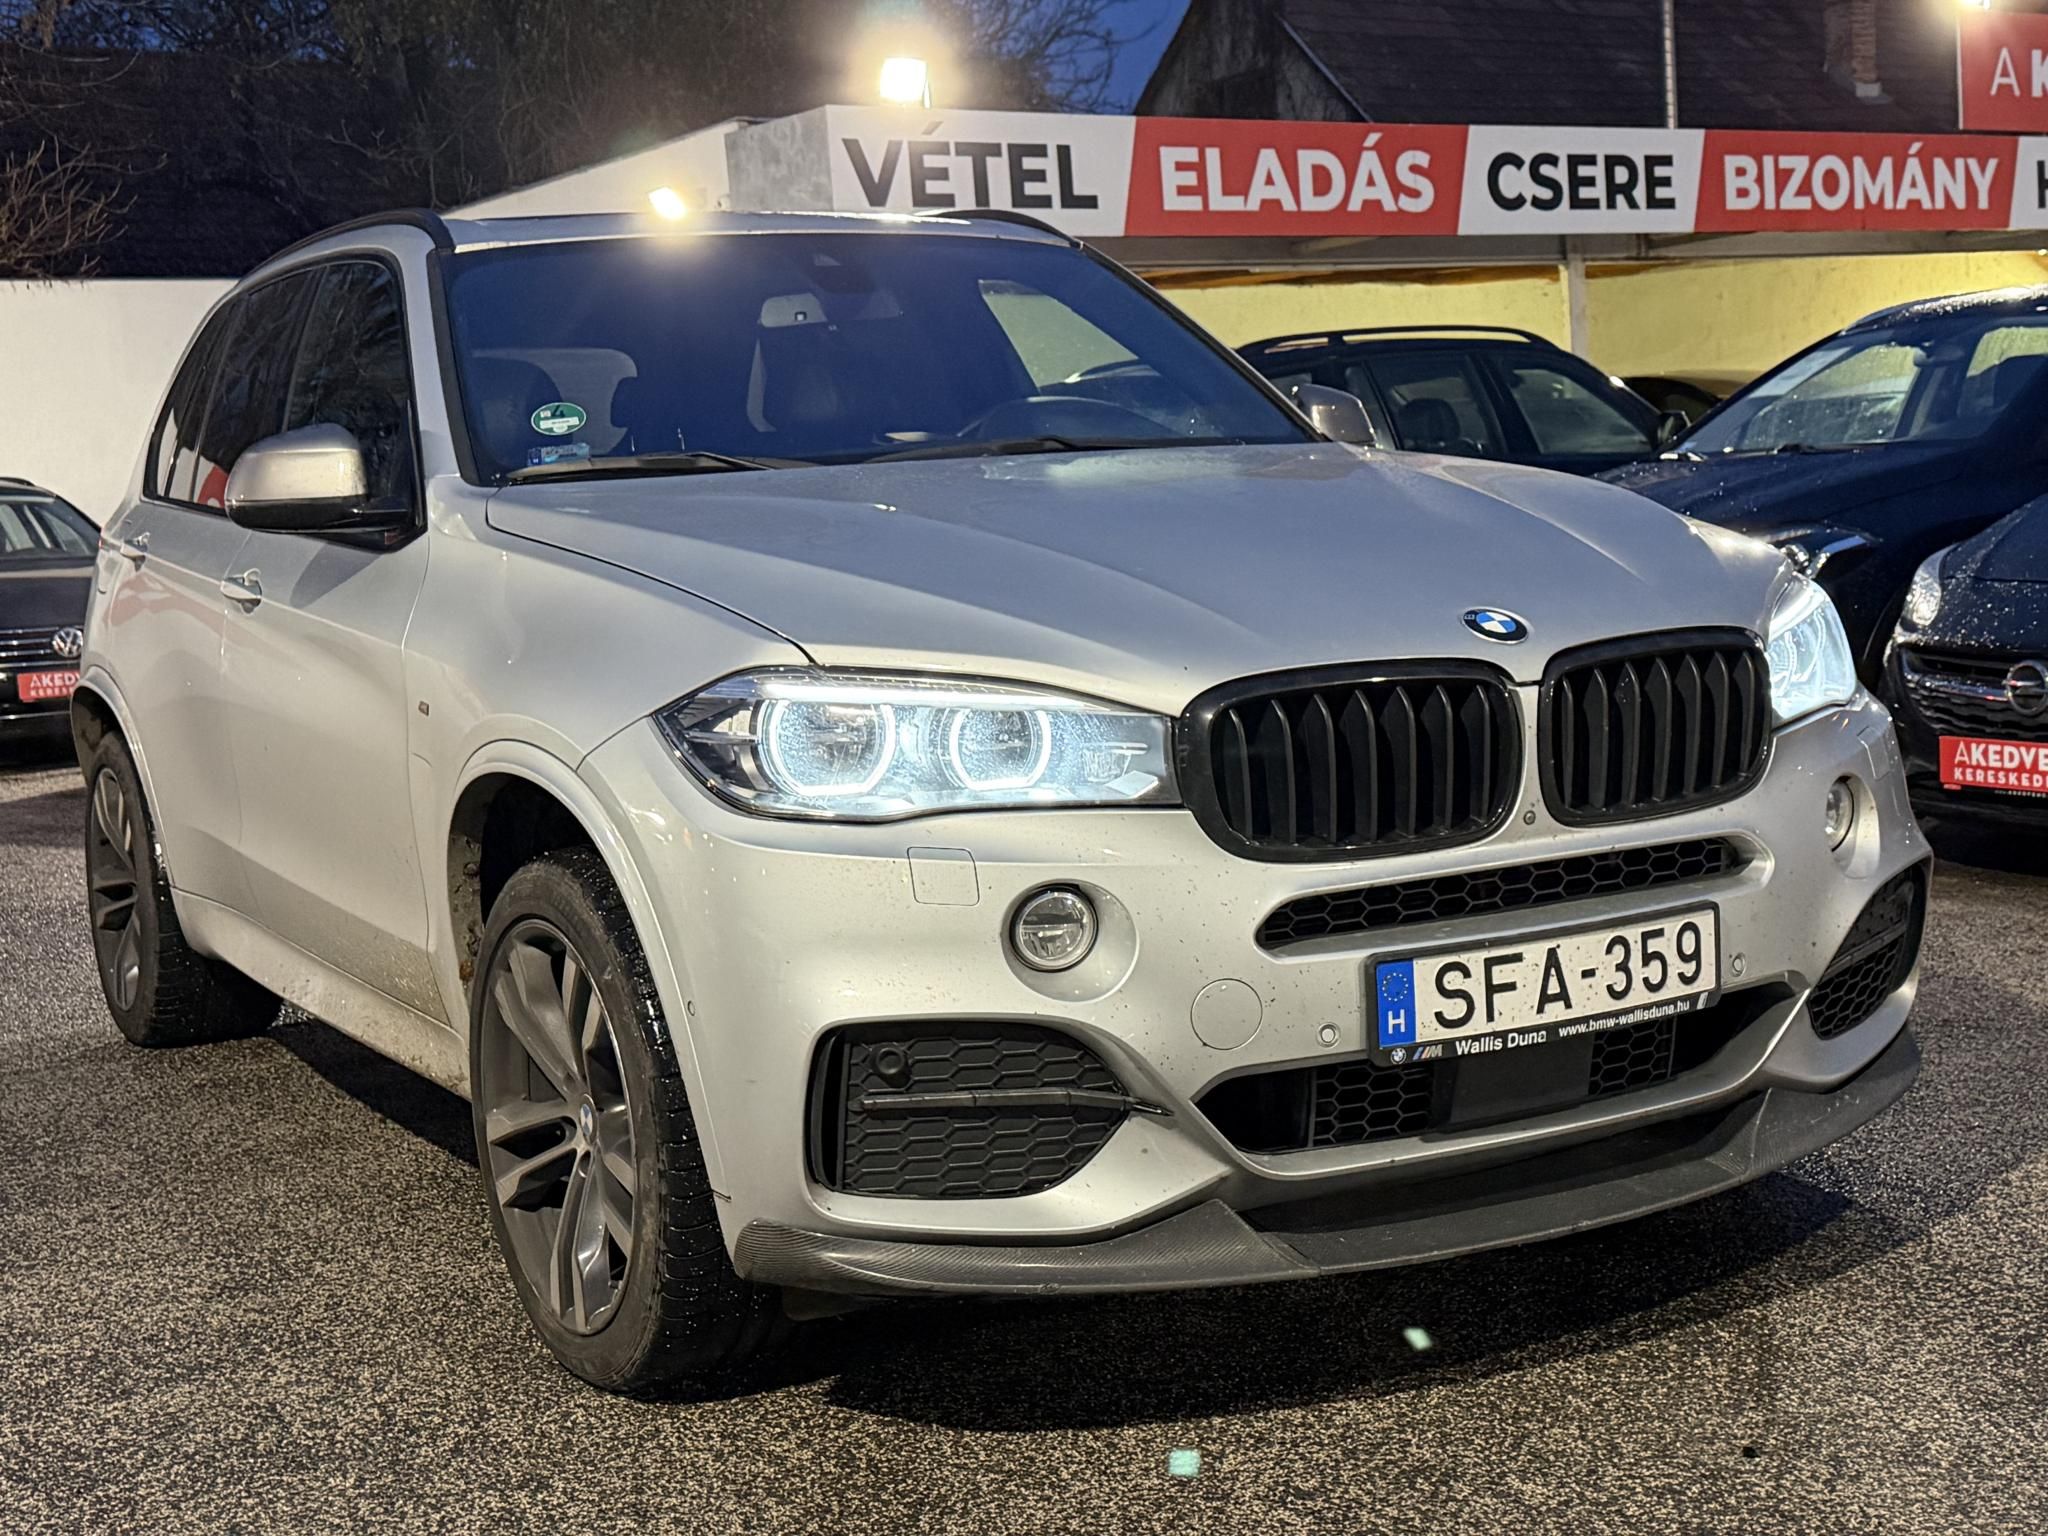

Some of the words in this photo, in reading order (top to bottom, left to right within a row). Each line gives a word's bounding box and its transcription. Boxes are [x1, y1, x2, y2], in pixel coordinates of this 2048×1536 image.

[1990, 47, 2021, 97] A
[841, 121, 1099, 209] VÉTEL
[1159, 132, 1434, 213] ELADÁS
[1487, 152, 1676, 212] CSERE
[1724, 142, 1998, 211] BIZOMÁNY
[1434, 921, 1702, 1030] SFA-359
[1388, 1008, 1406, 1035] H
[1455, 1034, 1503, 1056] Wallis
[1507, 1029, 1547, 1049] Duna
[1558, 1000, 1690, 1038] www.bmw-wallisduna.hu
